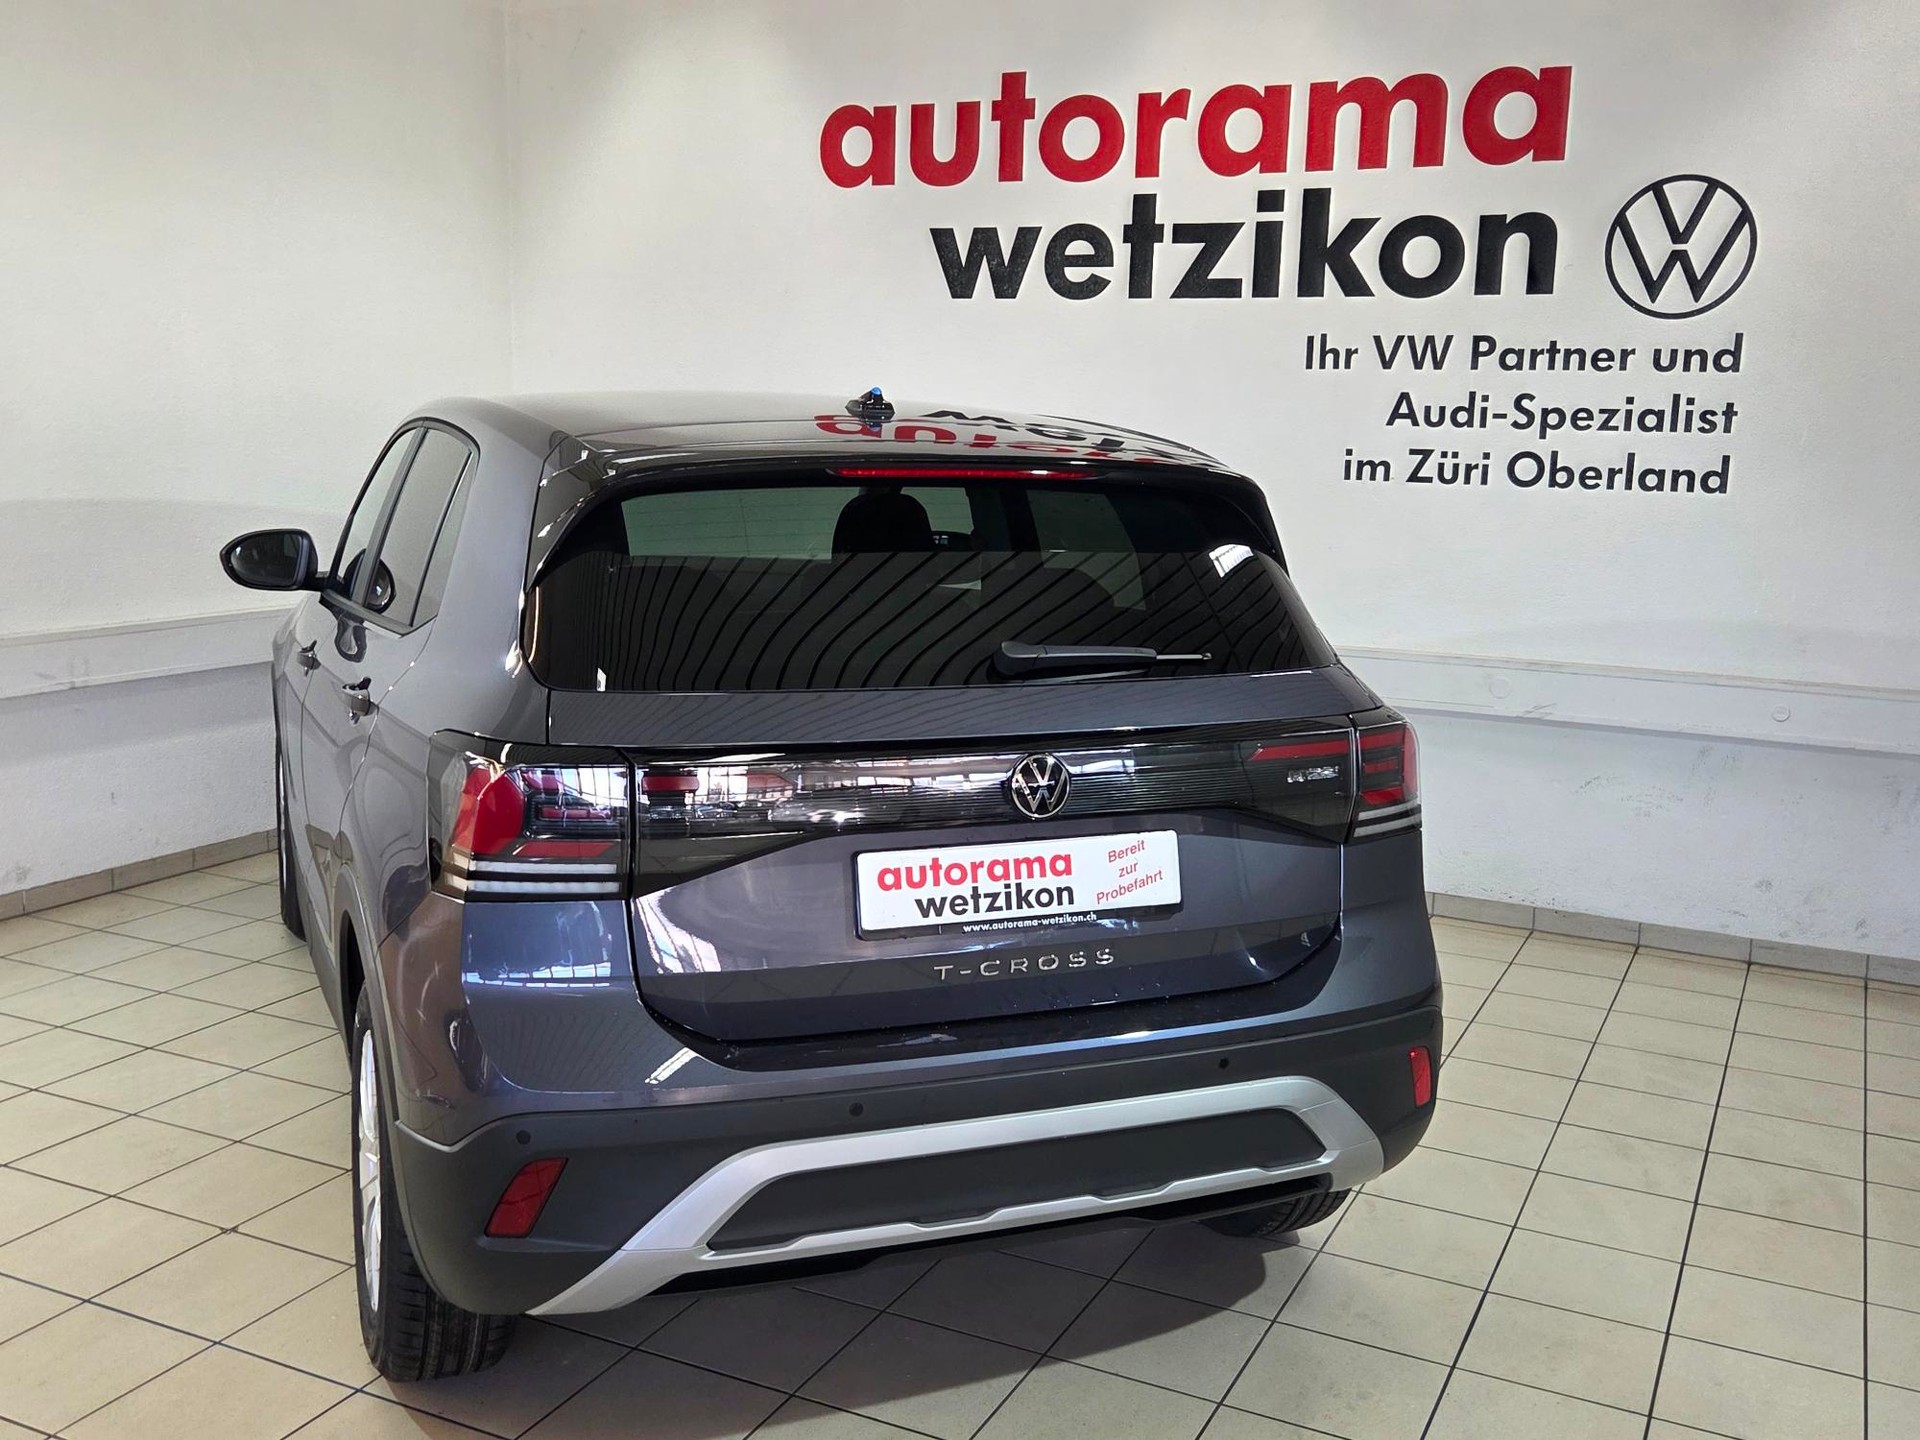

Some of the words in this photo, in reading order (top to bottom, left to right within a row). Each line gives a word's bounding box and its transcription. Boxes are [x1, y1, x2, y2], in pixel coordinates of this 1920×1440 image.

[819, 65, 1573, 188] autorama
[929, 187, 1558, 301] wetzikon
[1305, 333, 1359, 371] Ihr
[1372, 334, 1455, 371] VW
[1470, 334, 1637, 372] Partner
[1652, 332, 1745, 373] und
[1385, 390, 1739, 440] Audi-Spezialist
[1343, 448, 1392, 482] im
[1405, 448, 1491, 486] Züri
[1506, 450, 1731, 494] Oberland
[1107, 839, 1146, 863] Bereit
[1118, 862, 1139, 878] zur
[876, 852, 1074, 892] autorama
[1096, 869, 1164, 905] Probefahrt
[914, 883, 1076, 920] wetzikon
[962, 911, 1098, 934] www.autorama-wetzikon.ch
[933, 948, 1115, 981] T-CROSS
